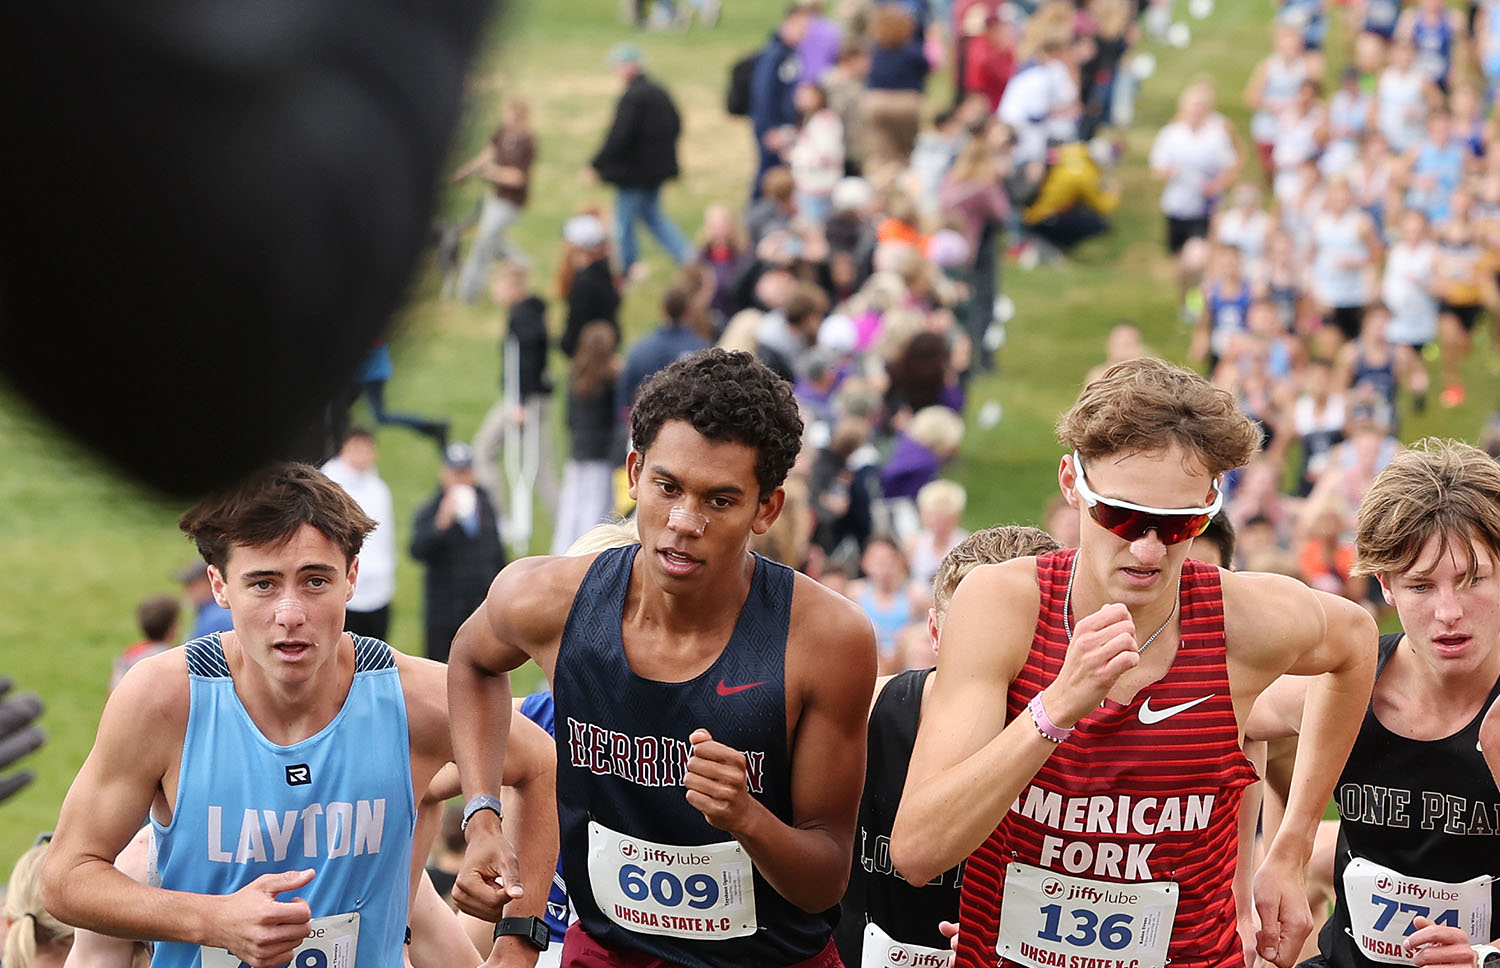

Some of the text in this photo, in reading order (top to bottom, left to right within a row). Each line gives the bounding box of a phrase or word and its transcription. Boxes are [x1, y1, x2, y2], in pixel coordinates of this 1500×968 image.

[567, 716, 765, 794] HERRIN
[1010, 784, 1216, 836] MERICAN
[1336, 783, 1411, 829] ONE
[207, 798, 387, 865] LAYTON
[1039, 834, 1157, 881] FORK
[618, 863, 720, 910] 609
[614, 903, 660, 928] UHSAA
[662, 914, 703, 932] STATE
[705, 917, 731, 932] X-C
[1037, 903, 1135, 951] 136
[1019, 941, 1067, 968] UHSAA
[1361, 934, 1403, 959] UHSAA
